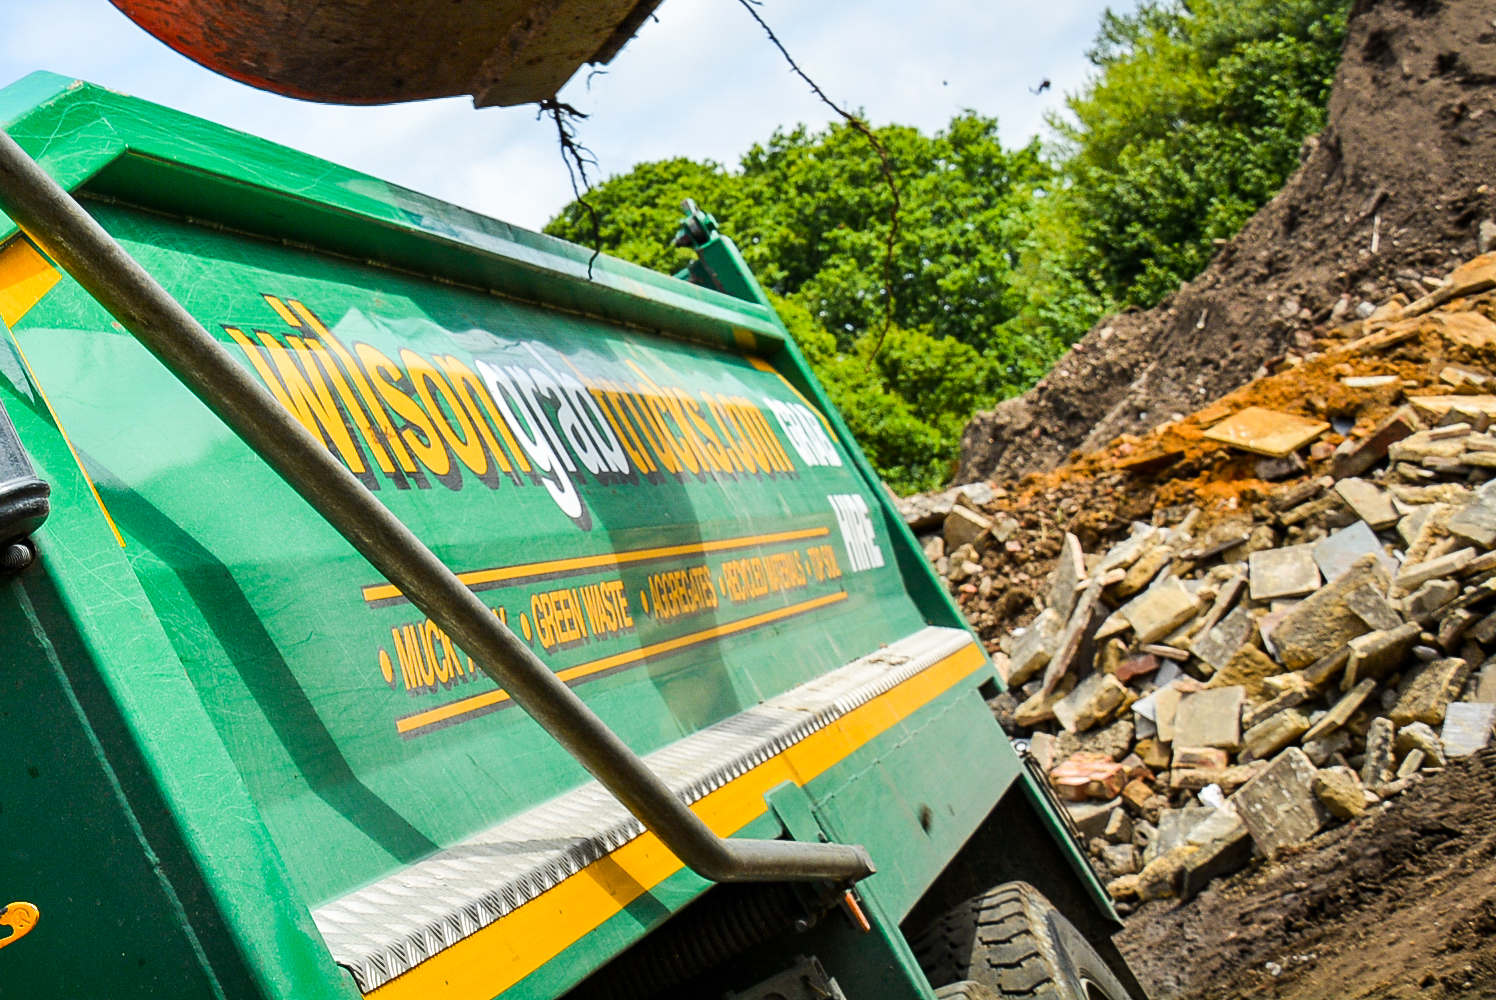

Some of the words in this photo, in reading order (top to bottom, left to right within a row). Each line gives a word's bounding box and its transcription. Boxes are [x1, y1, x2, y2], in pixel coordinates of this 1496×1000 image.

[222, 294, 796, 520] wilsongrabtrucks.com
[762, 396, 843, 467] GRAB
[826, 493, 886, 573] HIRE
[530, 589, 589, 650] GREEN
[579, 580, 635, 636] WASTE
[648, 565, 719, 620] AGGREGATES
